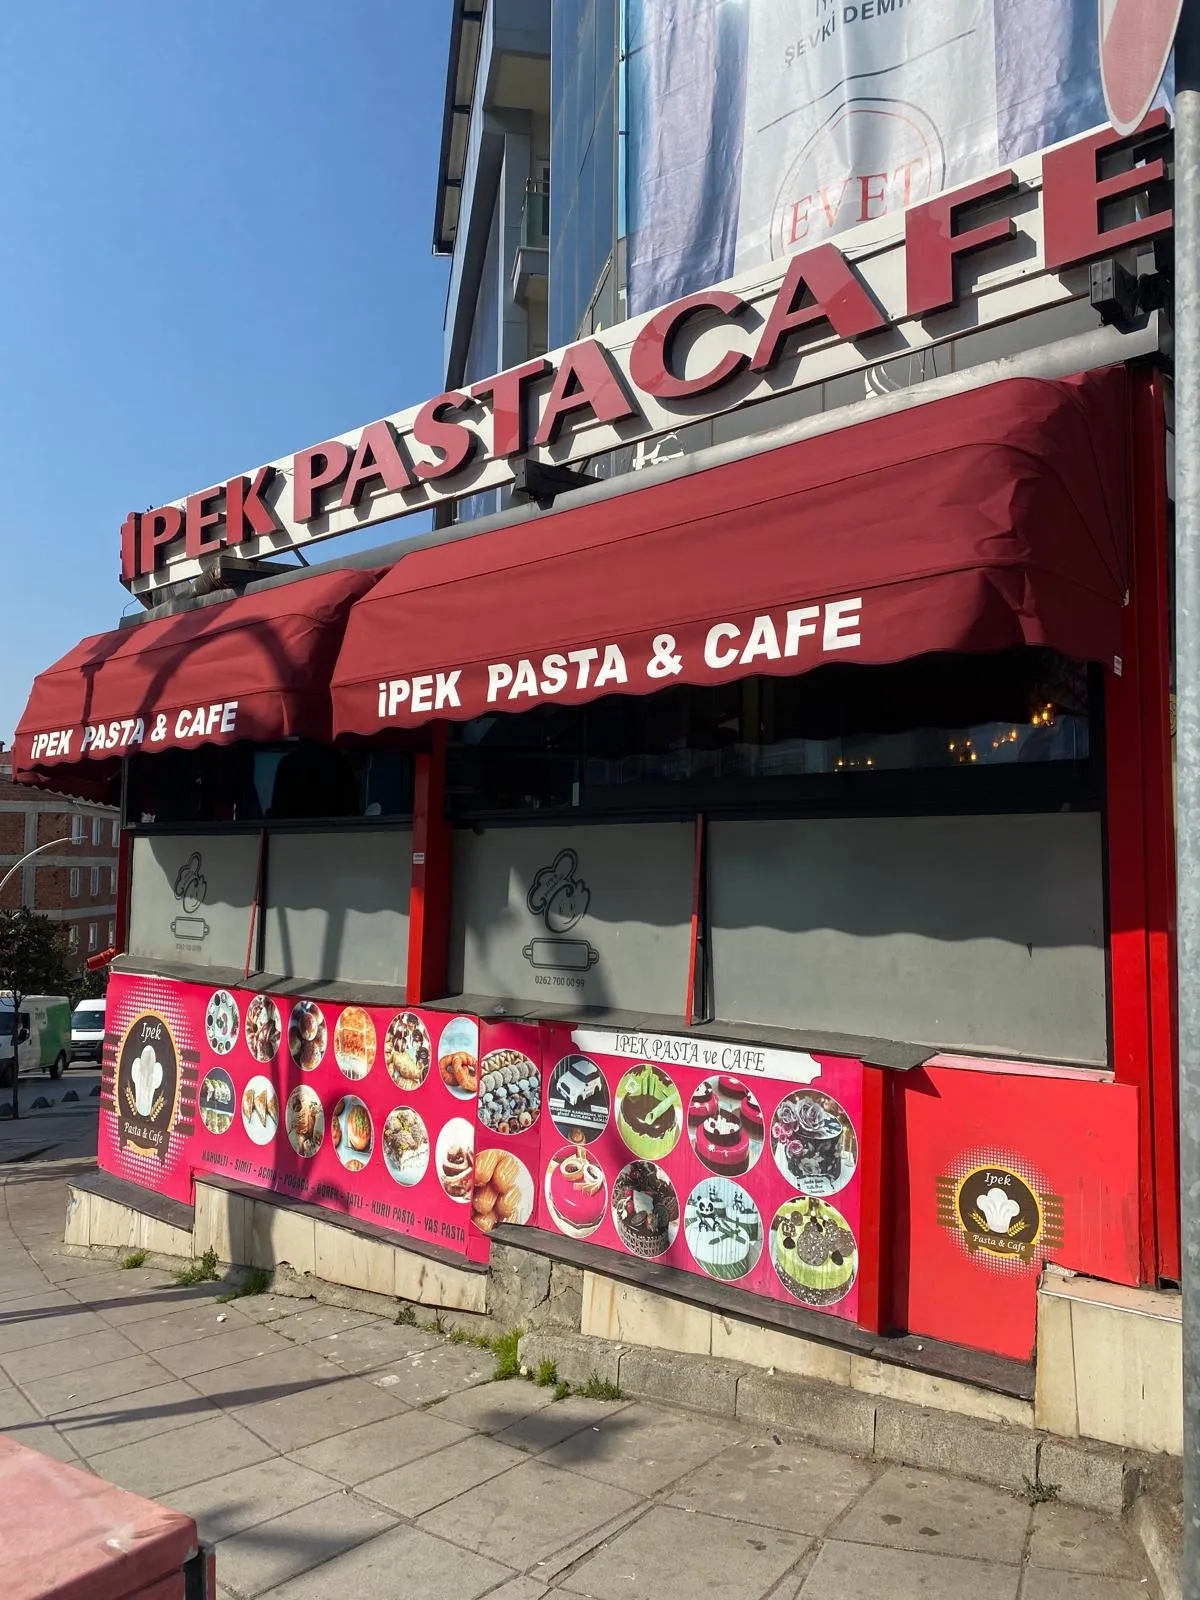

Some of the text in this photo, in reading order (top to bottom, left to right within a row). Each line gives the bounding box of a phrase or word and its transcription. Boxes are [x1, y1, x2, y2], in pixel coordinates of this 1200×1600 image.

[788, 158, 923, 245] EVET
[487, 644, 628, 703] PASTA
[646, 633, 684, 679] &
[703, 597, 862, 669] CAFE
[80, 717, 145, 752] PASTA
[150, 713, 168, 742] &
[174, 701, 238, 739] CAFE
[534, 975, 585, 988] 0262 700 00 99
[140, 1022, 162, 1042] Ipek
[614, 1034, 766, 1072] IPEK PASTA ve CAFE
[124, 1121, 163, 1146] Pasta & Cafe
[984, 1172, 1012, 1187] Ipek
[346, 1191, 364, 1209] TATLI
[371, 1199, 391, 1218] KURU
[392, 1207, 415, 1226] PASTA
[441, 1222, 465, 1243] PASTA
[972, 1234, 1026, 1253] Pasta & Cafe
